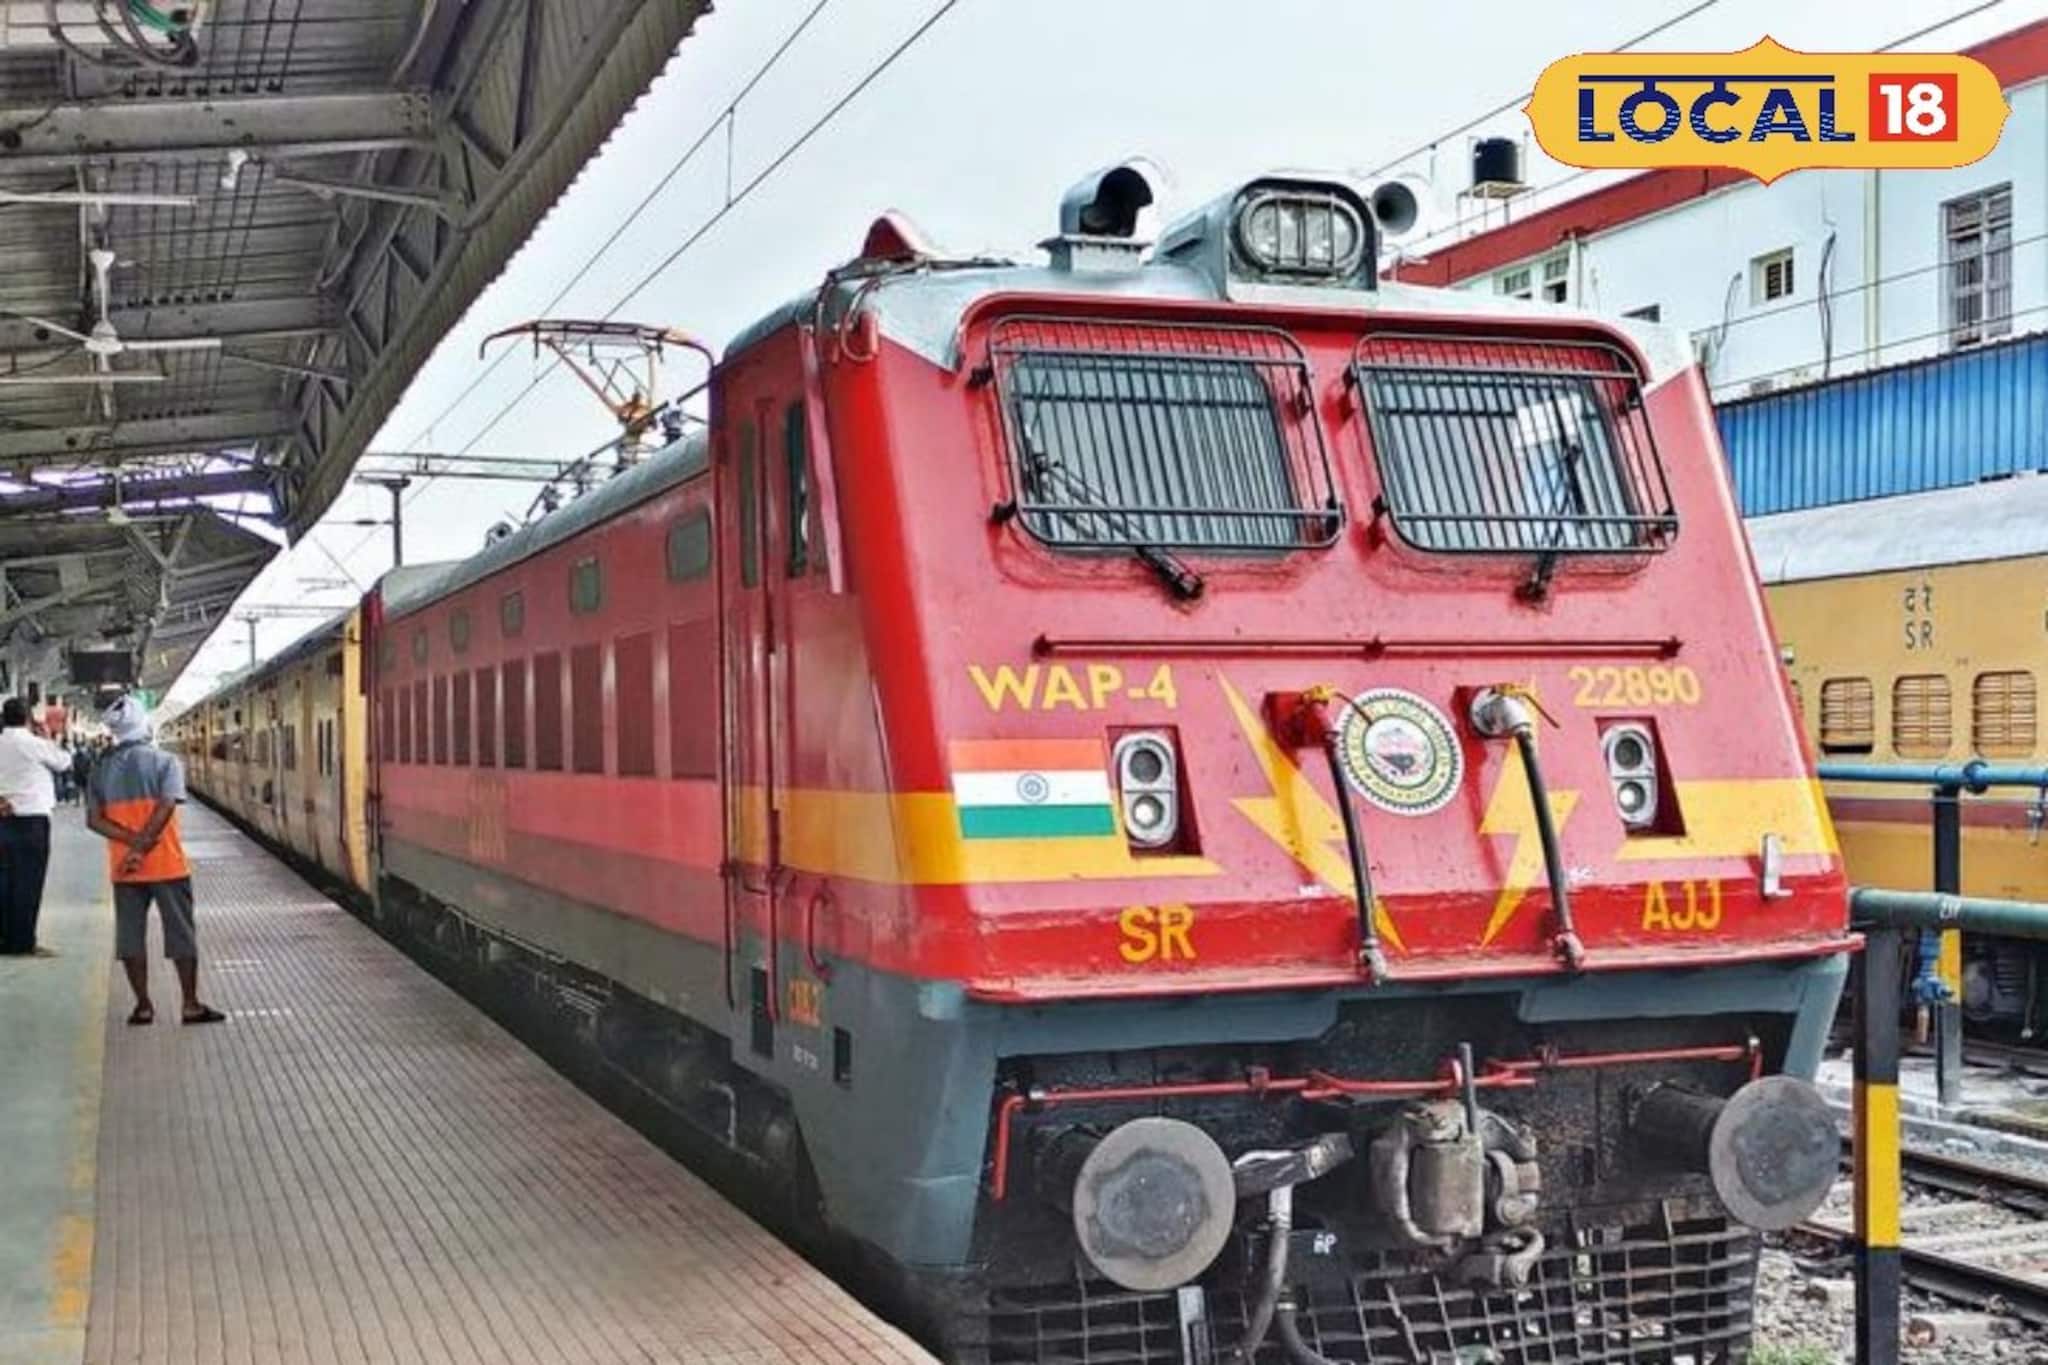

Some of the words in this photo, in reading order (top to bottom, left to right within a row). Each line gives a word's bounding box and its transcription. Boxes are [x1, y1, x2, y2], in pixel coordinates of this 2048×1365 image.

[1904, 620, 1933, 651] SR
[967, 663, 1179, 712] WAP-4
[1568, 665, 1702, 709] 22890
[1641, 879, 1722, 932] AJJ
[1118, 902, 1198, 964] SR
